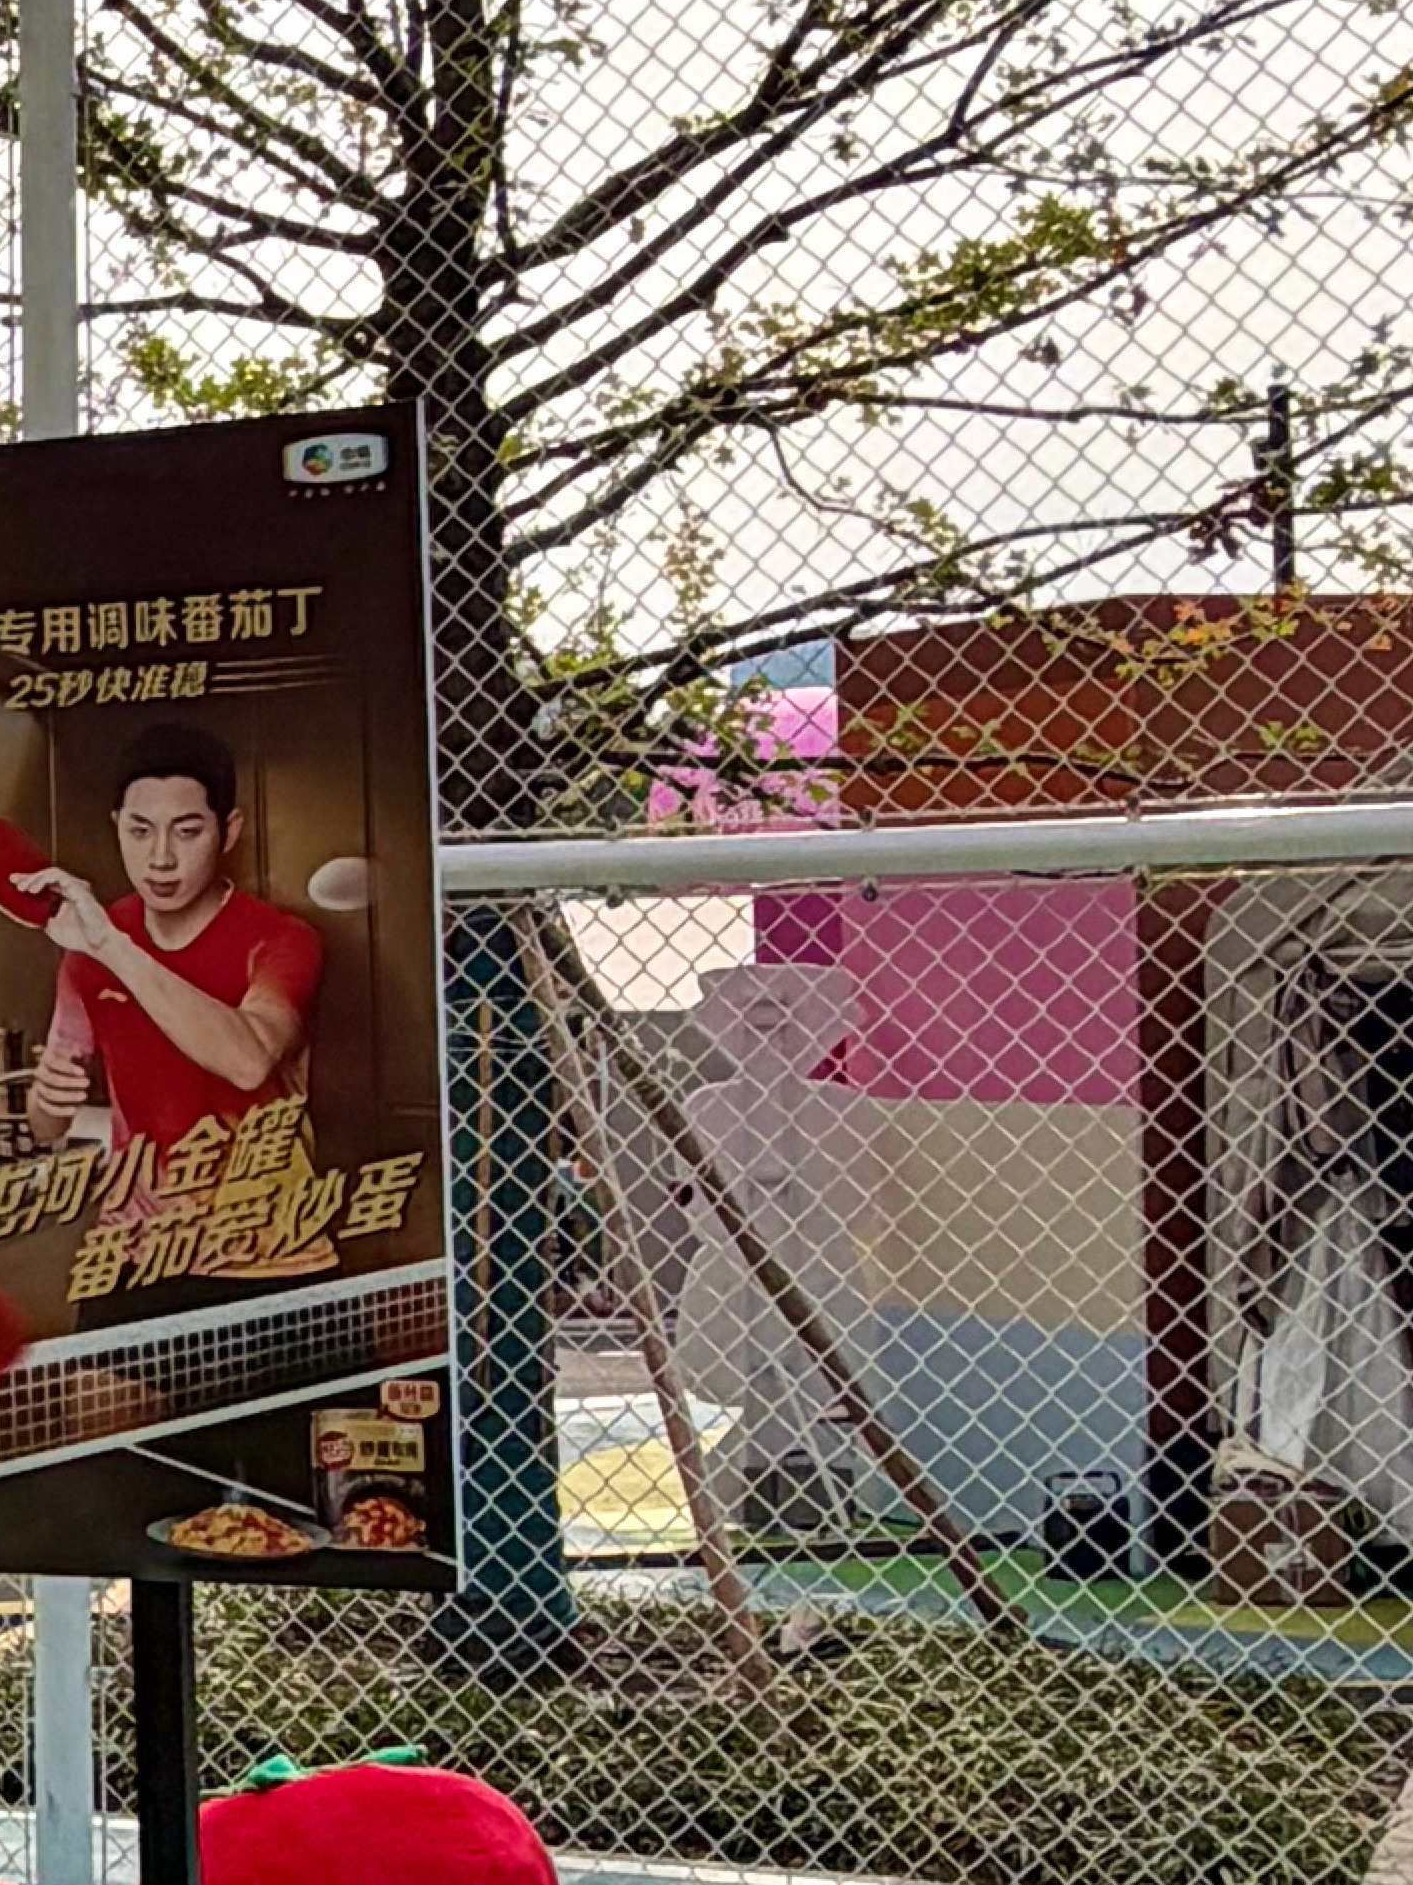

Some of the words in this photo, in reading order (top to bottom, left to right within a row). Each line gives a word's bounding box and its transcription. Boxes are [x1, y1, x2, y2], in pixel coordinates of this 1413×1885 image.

[4, 663, 211, 711] 25秒快准稳
[66, 1151, 425, 1304] 番茄爱炒蛋
